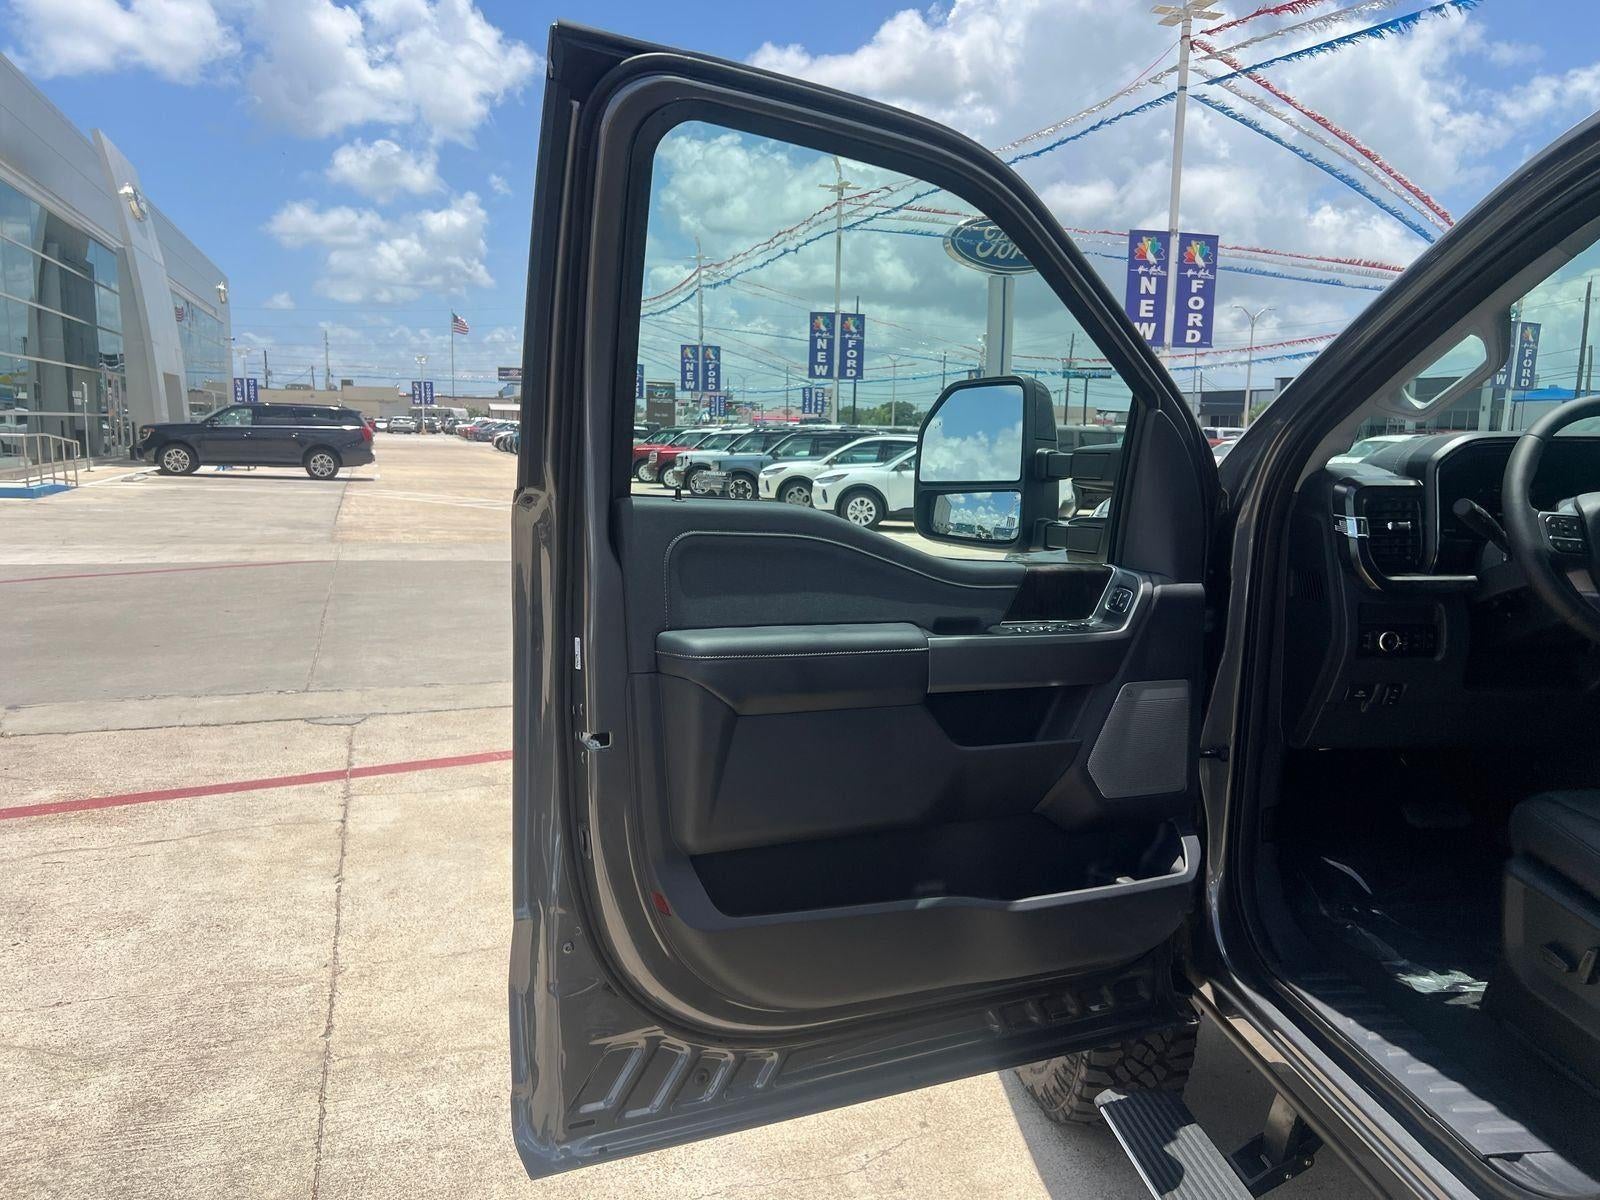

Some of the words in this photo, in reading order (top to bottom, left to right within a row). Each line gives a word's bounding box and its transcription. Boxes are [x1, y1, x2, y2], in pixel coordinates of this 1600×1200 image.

[976, 226, 1028, 260] For
[1134, 276, 1157, 340] NEW
[1185, 279, 1205, 343] FORD
[685, 362, 695, 389] NEW
[814, 338, 828, 376] NEW
[846, 339, 858, 377] FORD
[1520, 348, 1533, 387] FORD
[707, 363, 716, 390] FORD
